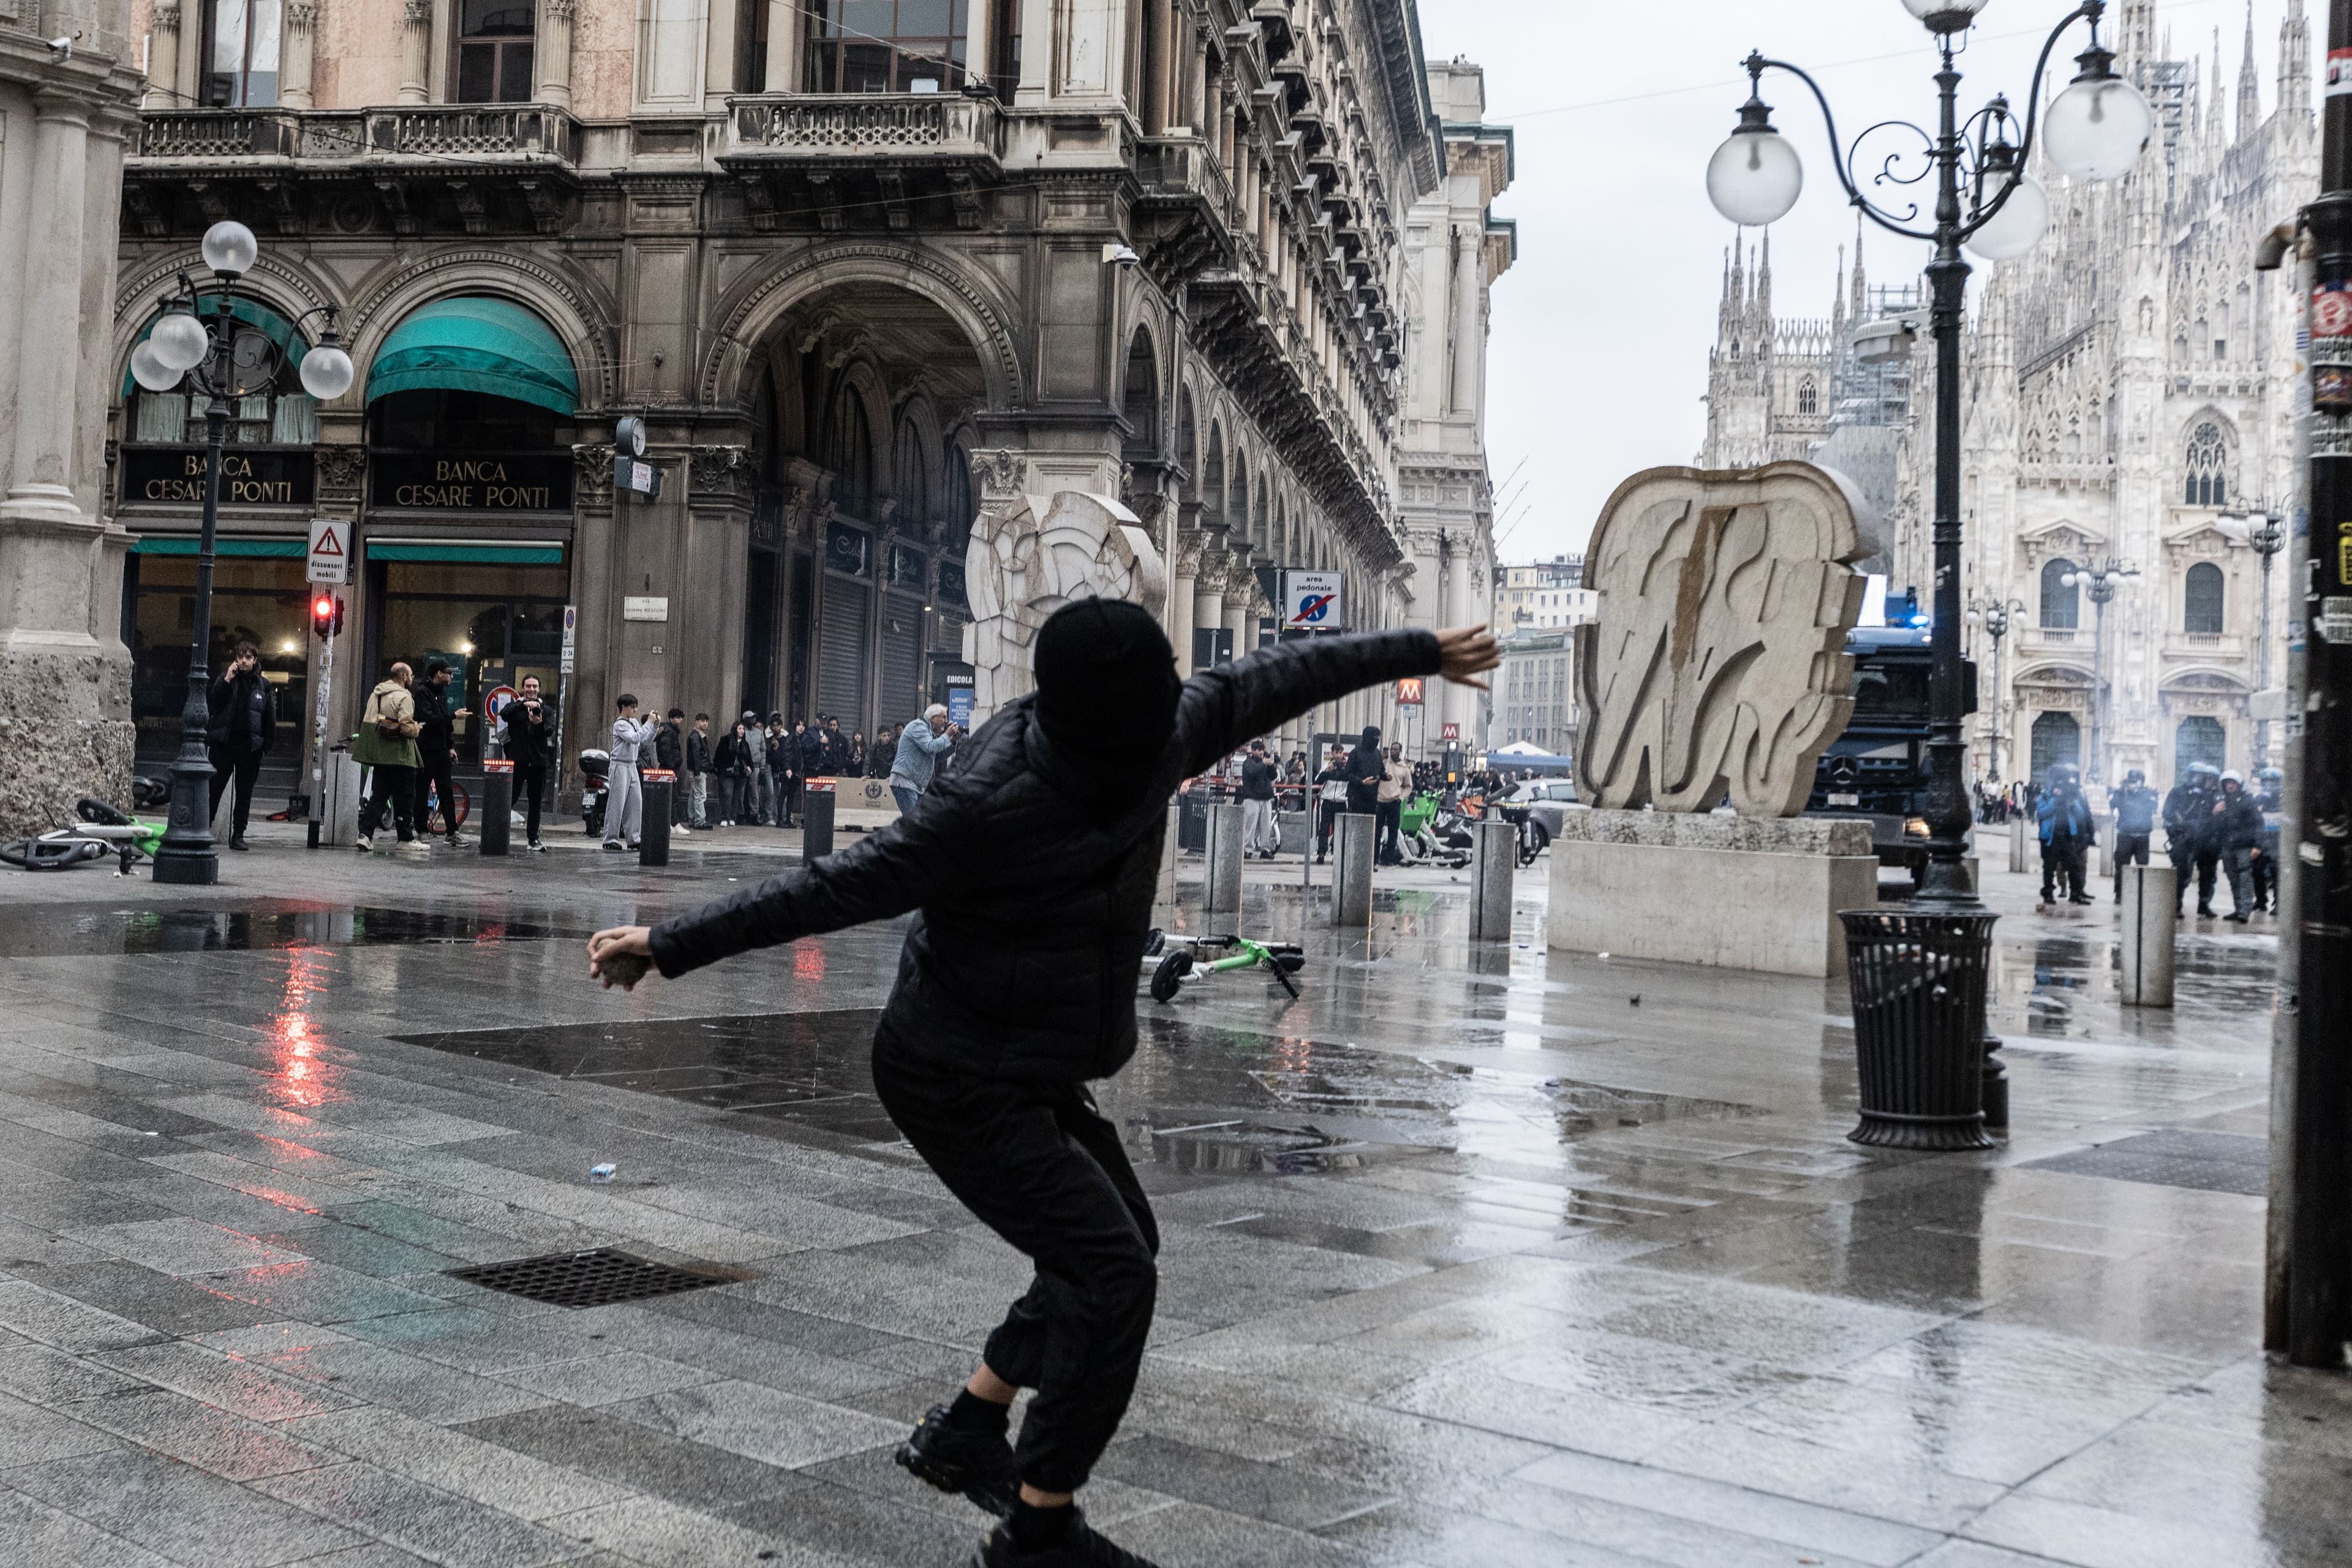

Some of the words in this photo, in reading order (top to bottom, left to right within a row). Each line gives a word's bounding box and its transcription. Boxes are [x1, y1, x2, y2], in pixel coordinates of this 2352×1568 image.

[185, 455, 252, 477] BACA
[436, 460, 507, 481] BANCA
[145, 479, 206, 501] CESAR
[230, 481, 292, 502] PONTI
[396, 484, 473, 507] CESARE
[485, 486, 549, 508] PONTI
[311, 560, 342, 570] dissuasori
[947, 675, 973, 684] EDICOLA
[1400, 684, 1421, 700] M
[1444, 726, 1457, 737] M
